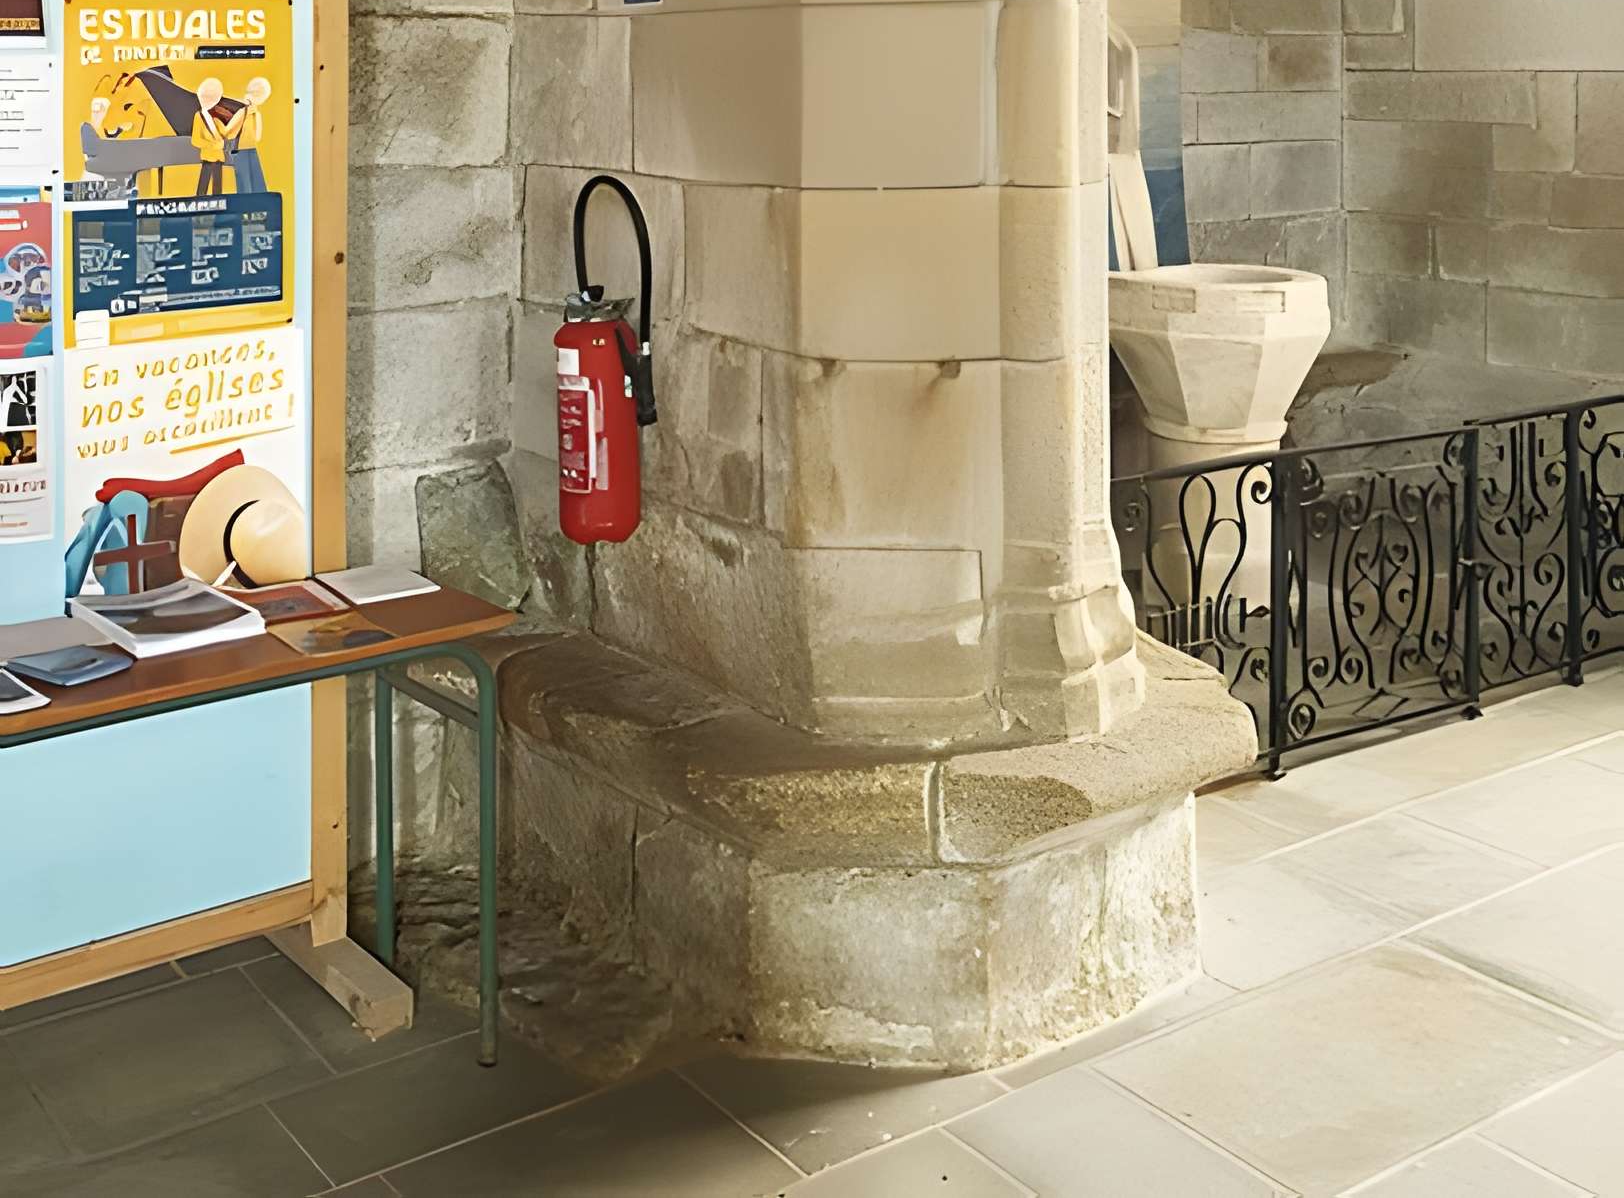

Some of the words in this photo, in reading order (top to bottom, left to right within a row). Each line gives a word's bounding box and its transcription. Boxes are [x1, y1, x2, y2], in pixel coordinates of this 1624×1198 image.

[82, 363, 119, 389] En
[81, 396, 145, 428] nos
[165, 369, 284, 418] églises
